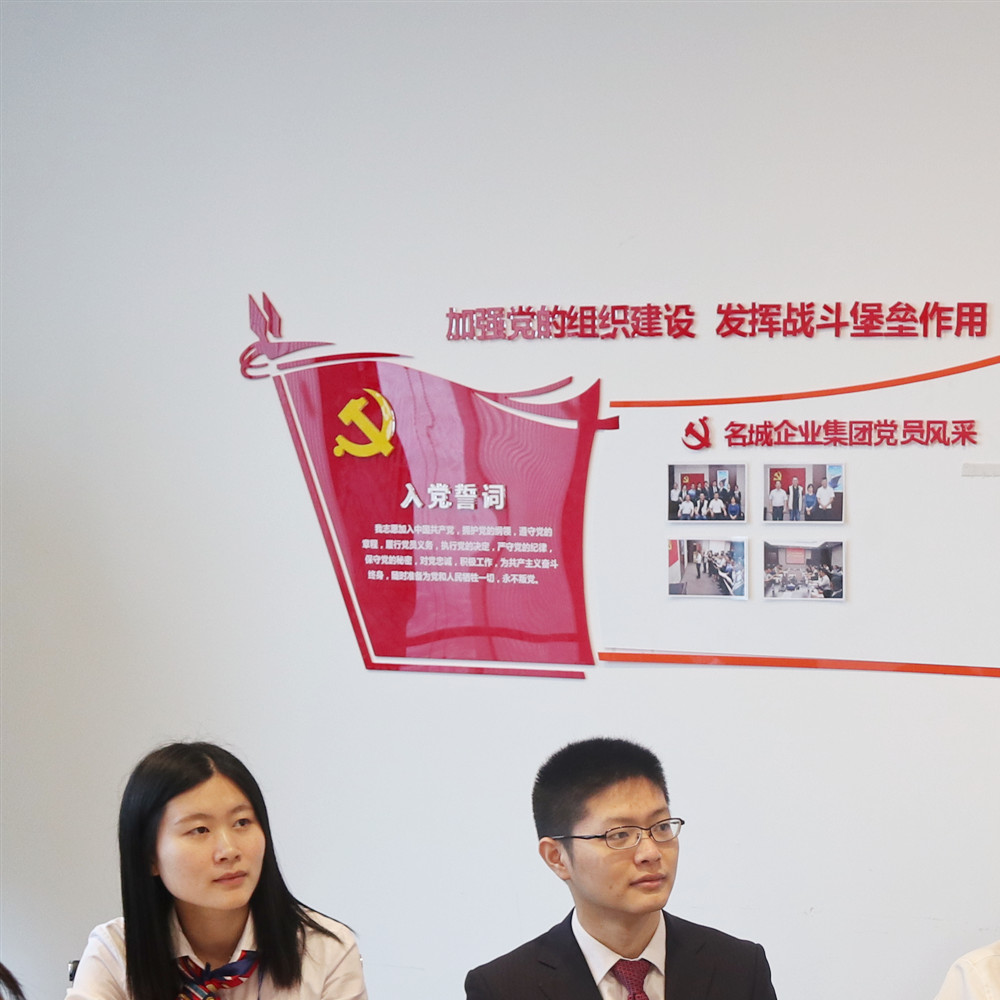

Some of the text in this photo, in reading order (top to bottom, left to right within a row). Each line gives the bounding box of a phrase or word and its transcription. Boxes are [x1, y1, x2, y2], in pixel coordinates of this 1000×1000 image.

[446, 301, 989, 341] 加强党的组织建设 发挥战斗堡垒作用
[724, 419, 978, 448] 名城企业集团党员风采
[400, 483, 507, 510] 入党誓词
